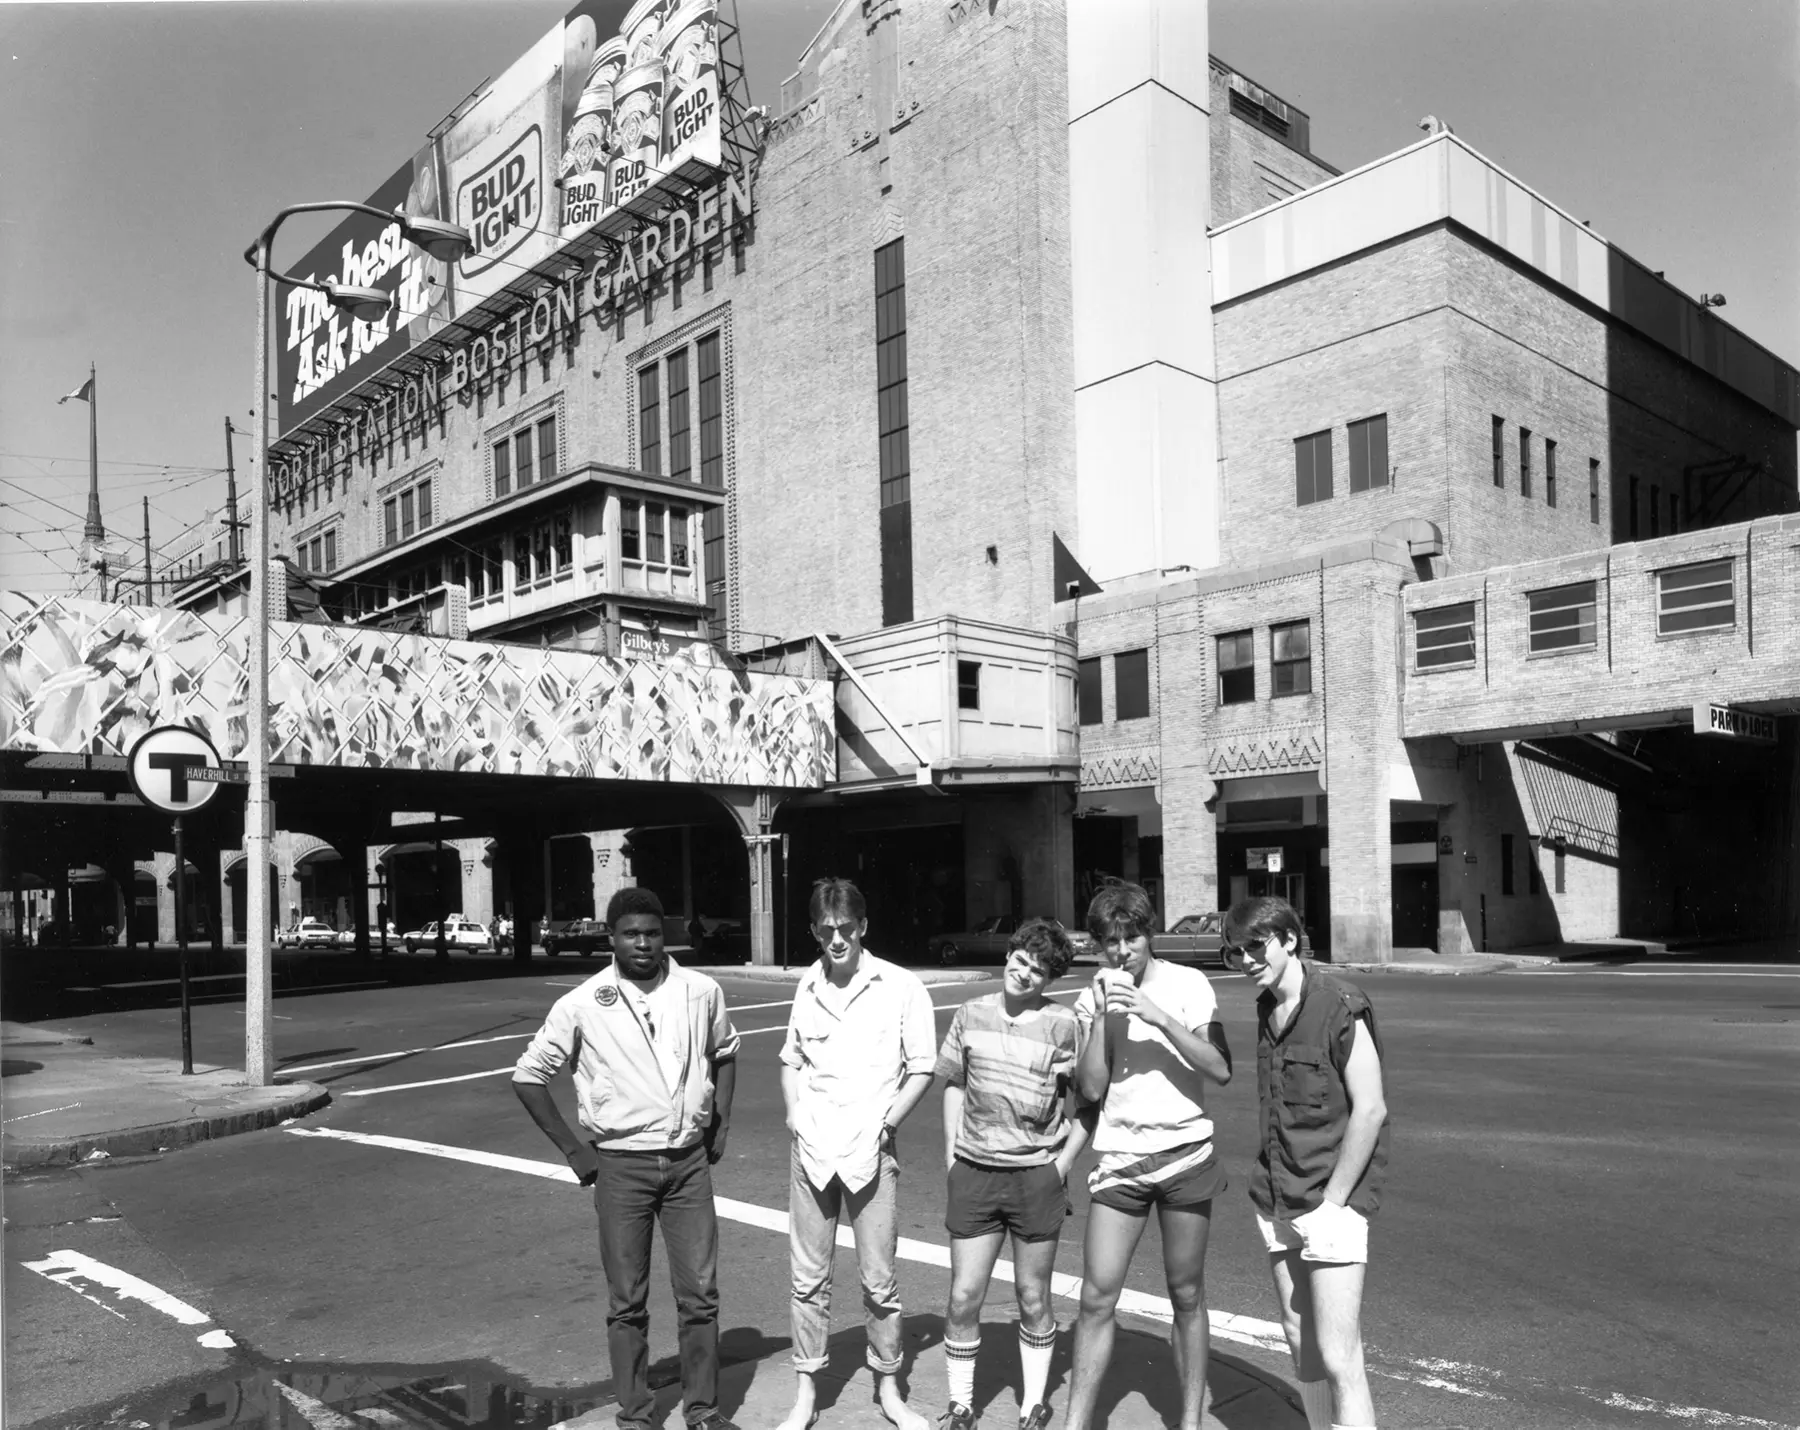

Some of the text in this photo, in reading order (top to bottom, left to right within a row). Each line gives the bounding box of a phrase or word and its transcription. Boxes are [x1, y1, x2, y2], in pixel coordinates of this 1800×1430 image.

[670, 102, 714, 153] LIGHT
[674, 87, 708, 128] BUD
[472, 154, 525, 220] BUD
[567, 182, 597, 206] BUD
[615, 160, 646, 188] BUD
[465, 178, 535, 260] IGHT
[560, 203, 599, 229] LIGHT
[337, 367, 437, 462] STATION
[453, 278, 575, 388] BOSTON
[590, 164, 751, 307] GARDEN
[293, 314, 348, 405] Ask
[1710, 707, 1740, 734] PARK
[149, 752, 207, 803] T
[187, 767, 231, 781] HAVERHILL
